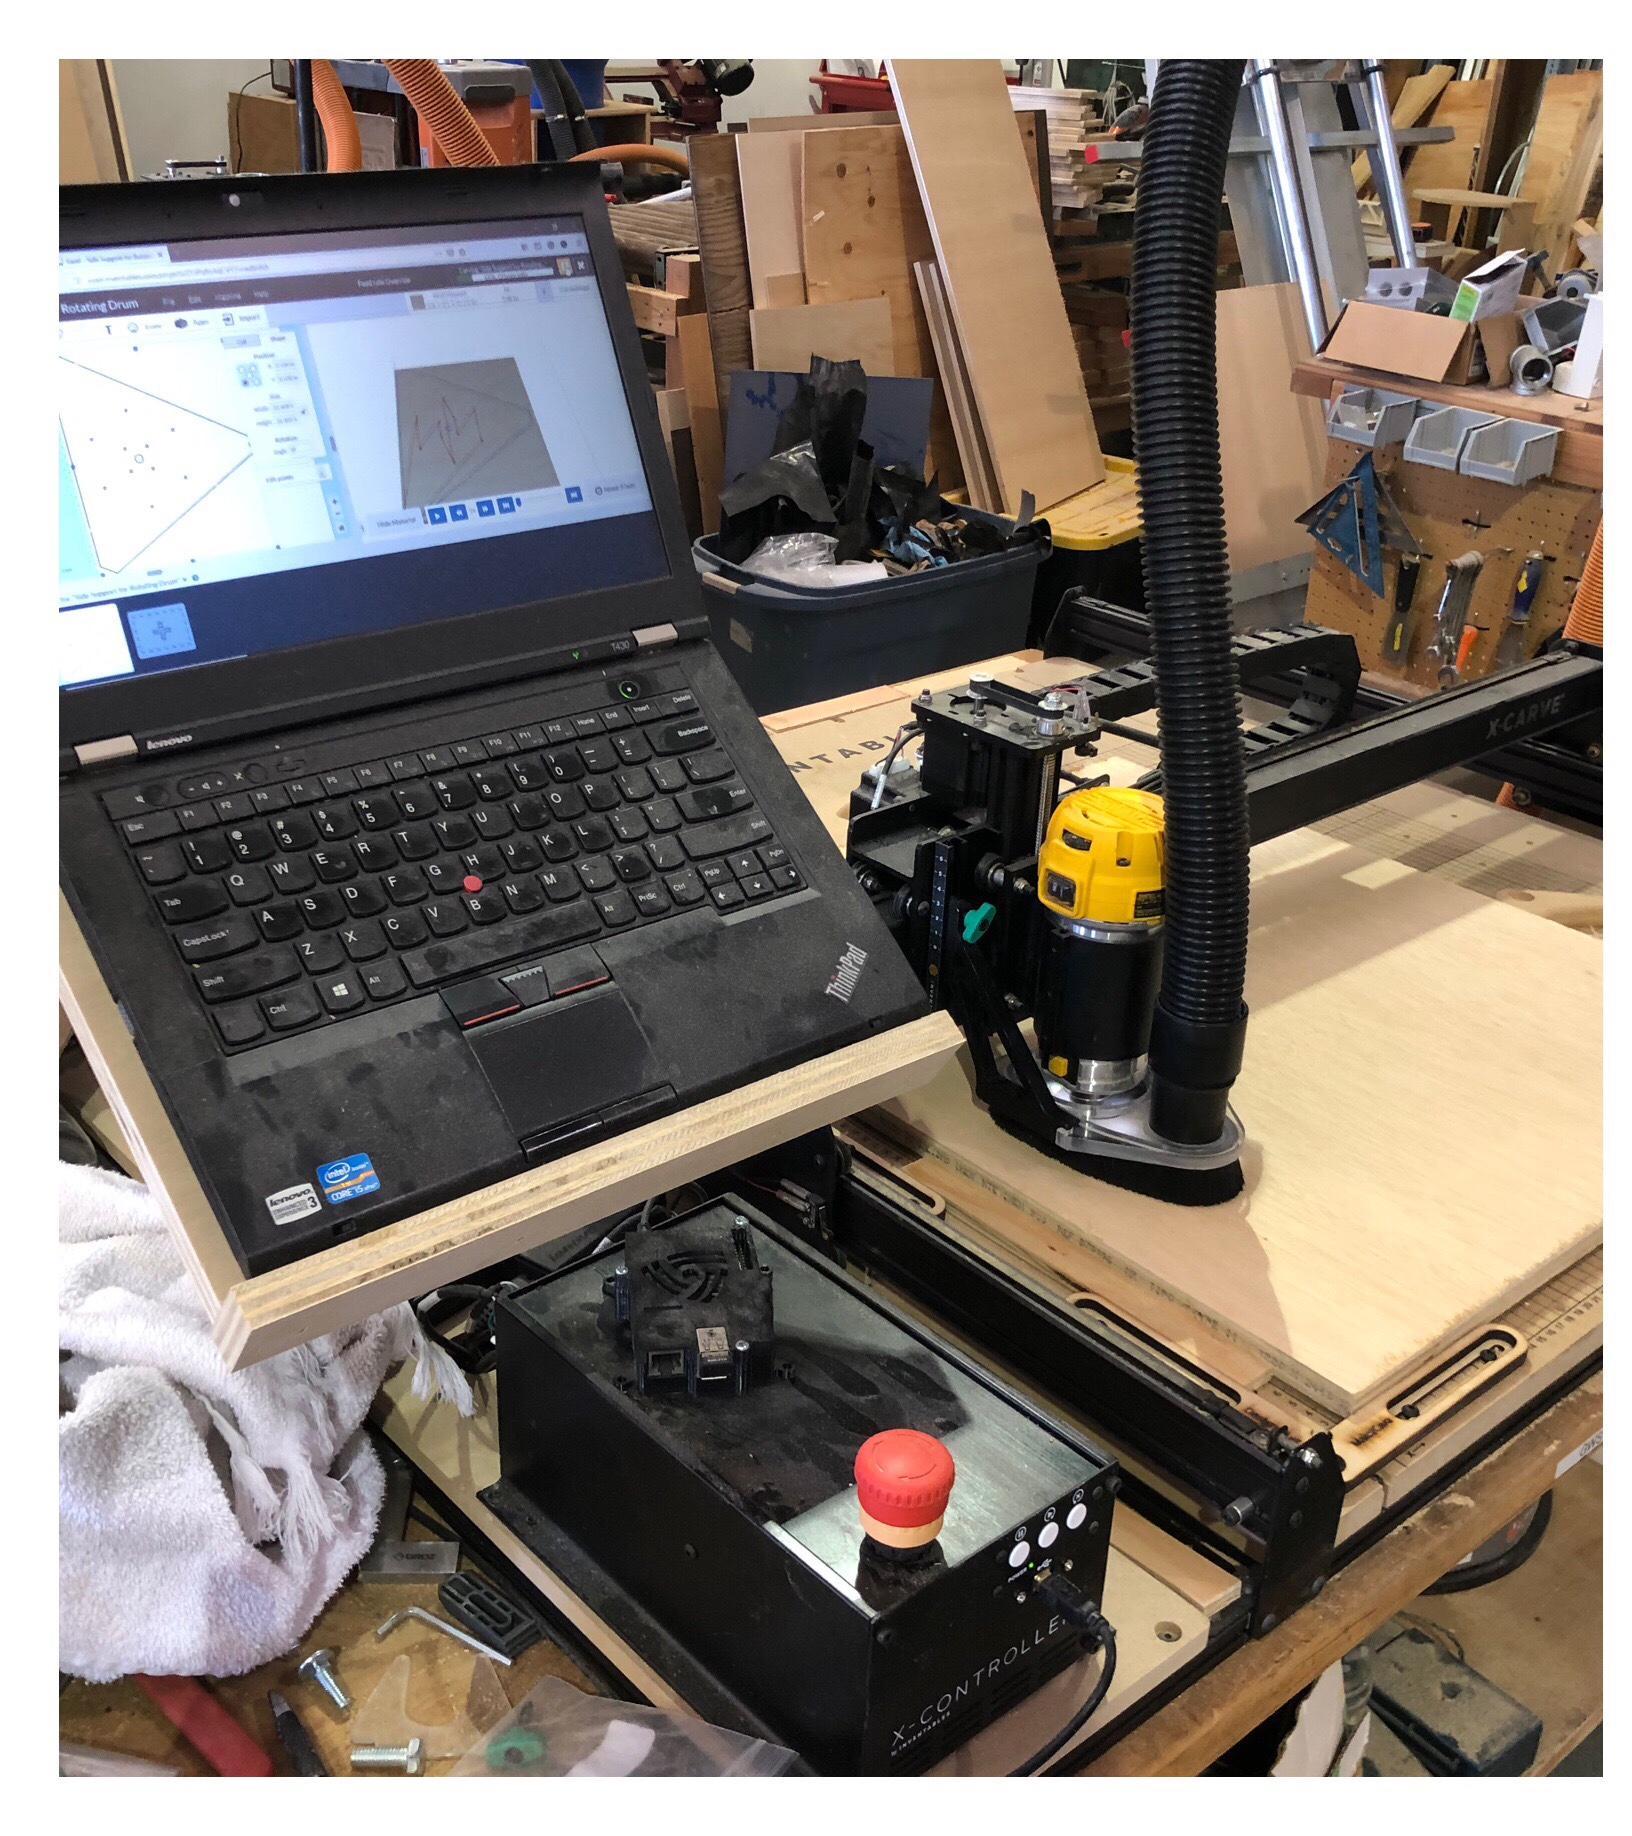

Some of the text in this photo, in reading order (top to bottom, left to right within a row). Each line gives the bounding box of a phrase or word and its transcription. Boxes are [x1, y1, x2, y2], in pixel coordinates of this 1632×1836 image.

[60, 298, 139, 315] Rotating Drum
[239, 313, 260, 322] Import
[610, 640, 630, 652] T430
[672, 694, 692, 704] Delete
[632, 703, 650, 713] Insert
[576, 716, 596, 726] Home
[604, 711, 618, 720] End
[548, 724, 562, 733] F12
[677, 724, 709, 738] Backspace
[519, 731, 532, 740] F11
[146, 734, 193, 750] lenovo
[488, 738, 503, 747] F10
[457, 746, 468, 754] F9
[426, 753, 437, 762] F8
[393, 760, 403, 769] F7
[360, 768, 372, 777] F6
[555, 766, 564, 776] 0
[326, 776, 338, 785] F5
[519, 775, 528, 785] 9
[292, 783, 303, 792] F4
[482, 784, 492, 794] 8
[584, 784, 594, 794] P
[729, 787, 747, 798] Enter
[256, 792, 268, 801] F3
[443, 793, 452, 803] 7
[550, 793, 562, 804] O
[220, 801, 232, 810] F2
[405, 803, 415, 813] 6
[513, 803, 521, 814] I
[183, 810, 195, 818] F1
[366, 812, 376, 823] 5
[476, 812, 488, 823] U
[127, 823, 144, 832] Esc
[325, 823, 334, 834] 4
[437, 821, 448, 833] Y
[750, 819, 767, 830] Shift
[578, 825, 589, 836] L
[281, 833, 293, 844] 3
[398, 831, 409, 843] T
[542, 834, 554, 846] K
[239, 844, 250, 855] 2
[357, 842, 371, 854] R
[507, 844, 516, 857] J
[769, 848, 785, 858] PgDn
[195, 854, 204, 866] 1
[315, 852, 329, 865] E
[466, 854, 480, 866] H
[272, 861, 290, 875] W
[429, 864, 443, 877] G
[704, 867, 721, 878] PgUp
[229, 874, 245, 887] Q
[388, 876, 398, 888] F
[543, 873, 558, 886] M
[505, 884, 519, 896] N
[673, 882, 687, 892] Ctrl
[346, 887, 358, 900] D
[638, 891, 658, 903] PrtSc
[164, 898, 182, 908] Tab
[304, 899, 317, 911] S
[469, 899, 482, 911] B
[604, 904, 615, 913] Alt
[262, 910, 275, 923] A
[427, 907, 439, 918] V
[387, 918, 400, 931] C
[183, 930, 227, 948] CapsLock
[344, 930, 358, 943] X
[301, 943, 315, 956] Z
[825, 941, 869, 1003] ThinkPad
[202, 975, 225, 988] Shift
[369, 976, 381, 985] Alt
[269, 1003, 287, 1015] Ctrl
[327, 1165, 348, 1180] intel
[307, 1196, 318, 1208] 3
[1008, 1566, 1028, 1583] POWER
[892, 1613, 1067, 1747] X-CONTROLLE
[899, 1711, 951, 1751] INVENTABLES
